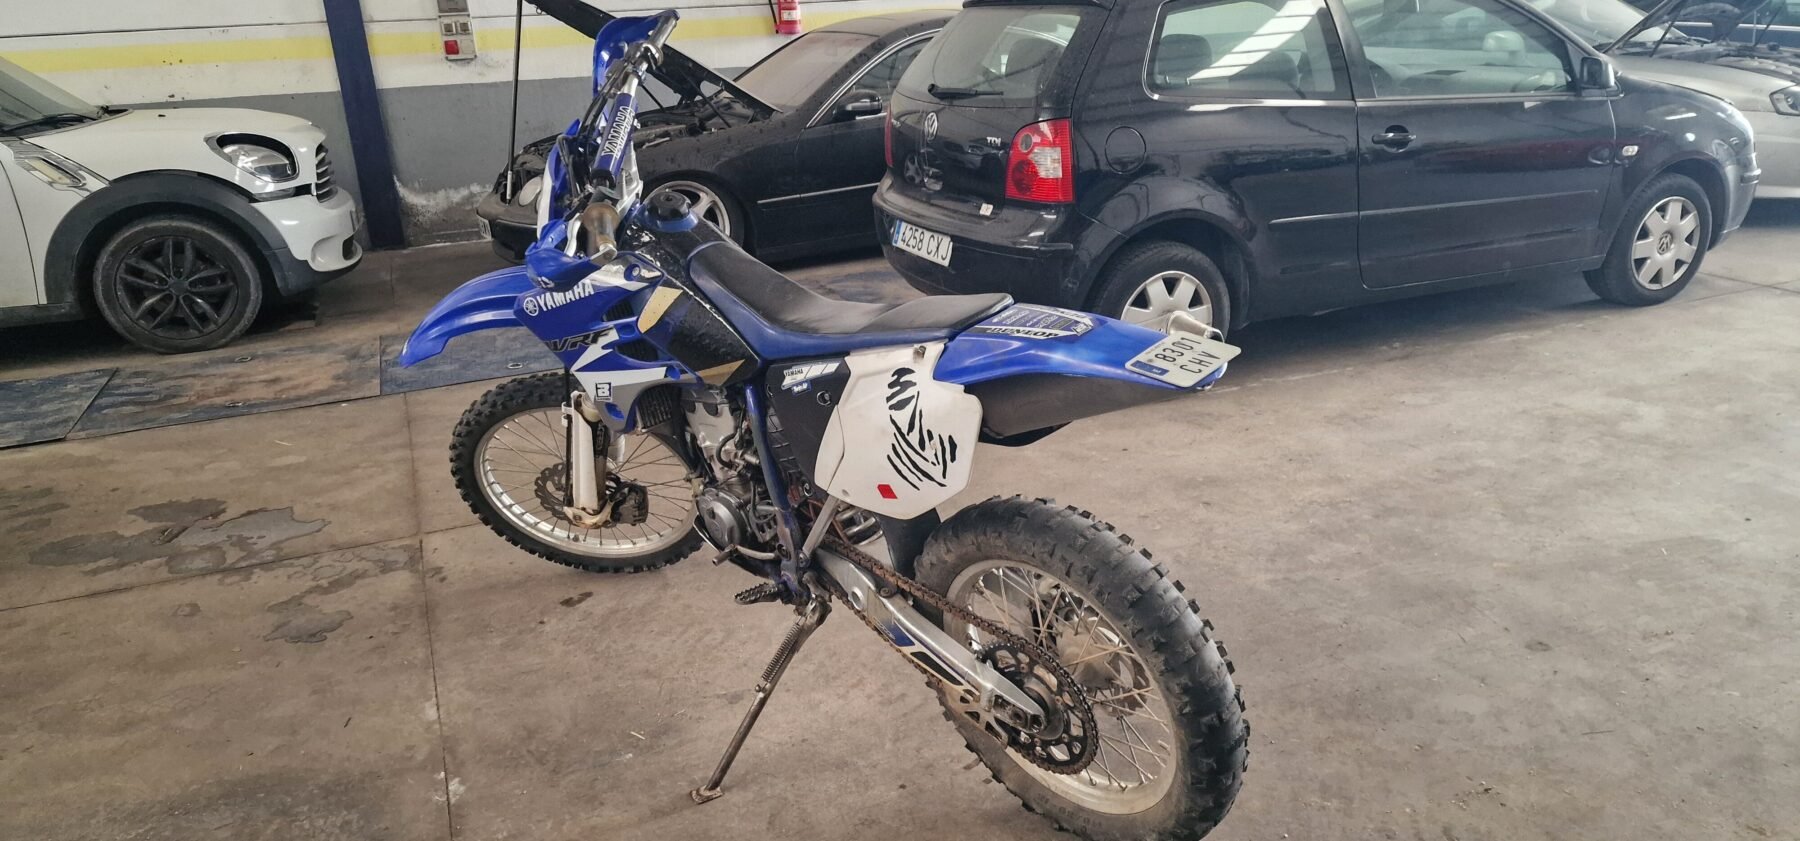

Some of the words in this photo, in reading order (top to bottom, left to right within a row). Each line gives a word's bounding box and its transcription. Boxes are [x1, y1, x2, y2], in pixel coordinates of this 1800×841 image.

[601, 106, 630, 156] YAMAHA
[901, 225, 925, 251] 4258
[926, 234, 951, 261] CXJ
[537, 280, 595, 312] YAMAHA
[986, 327, 1060, 338] DUNLOP
[1155, 337, 1202, 363] 8301
[1180, 351, 1221, 374] CHV
